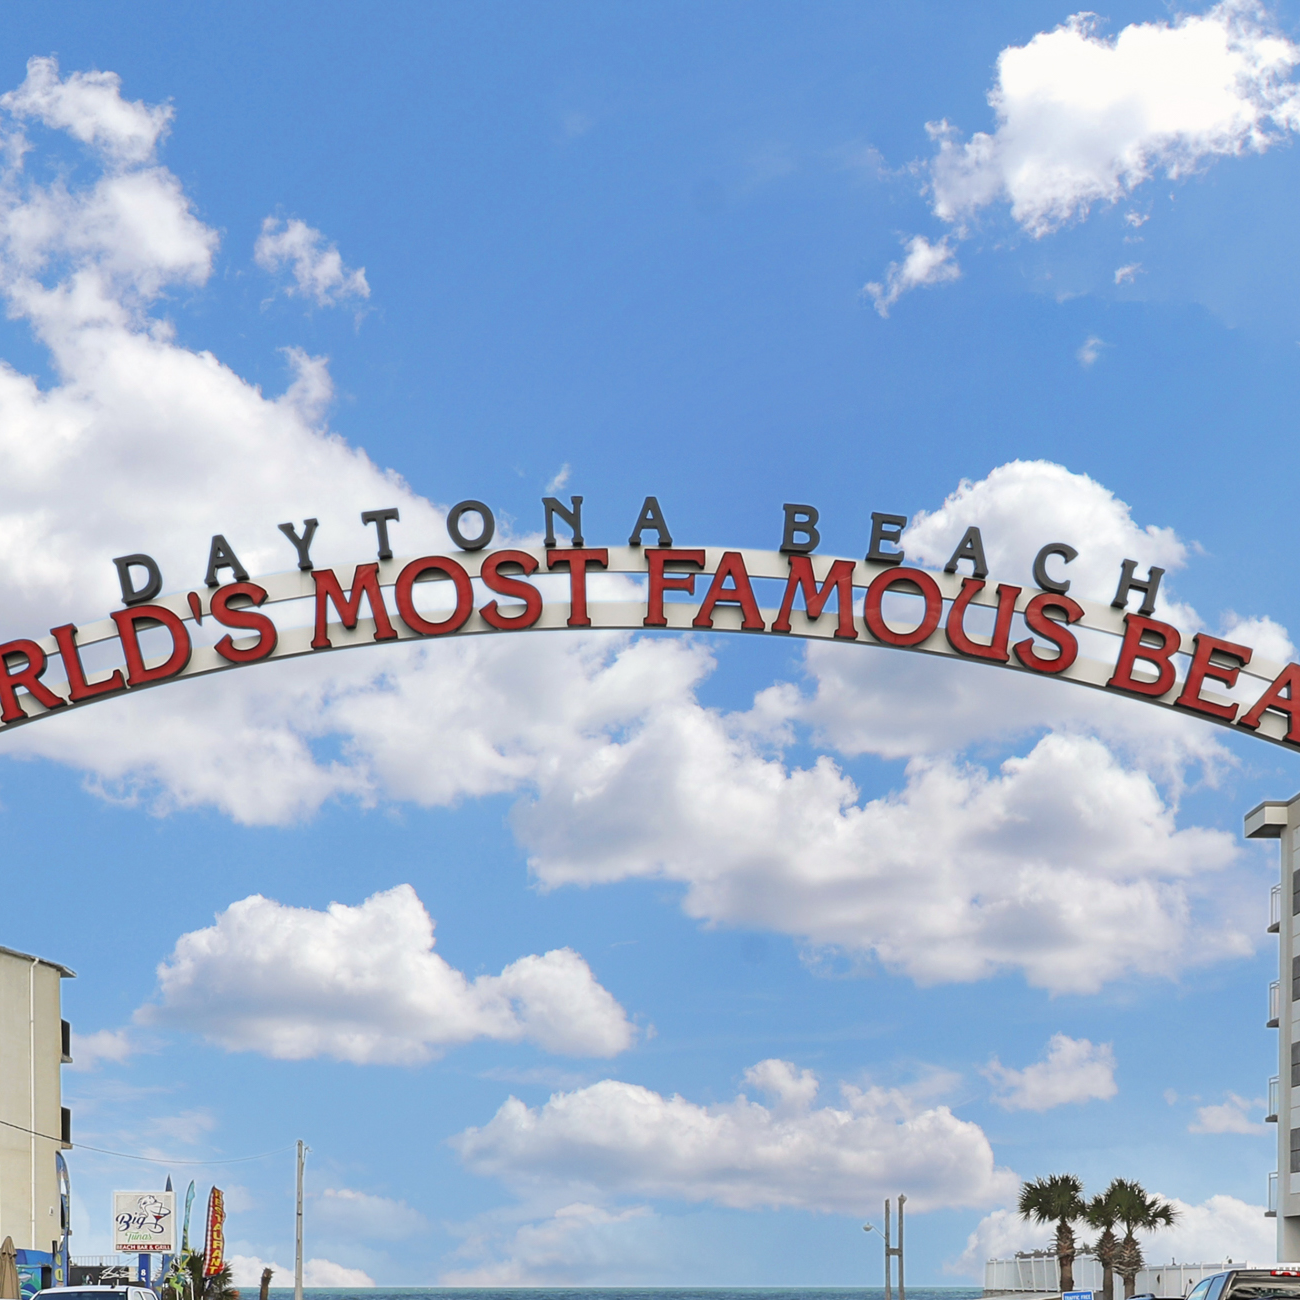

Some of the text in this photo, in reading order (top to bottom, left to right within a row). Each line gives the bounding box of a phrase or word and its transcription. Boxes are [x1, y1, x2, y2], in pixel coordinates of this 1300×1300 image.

[112, 496, 1167, 616] DAYTONA BEACH
[310, 548, 609, 651] MOST
[643, 548, 1086, 675] FAMOUS
[116, 1212, 146, 1232] Big
[209, 1189, 224, 1275] RESTAURANT
